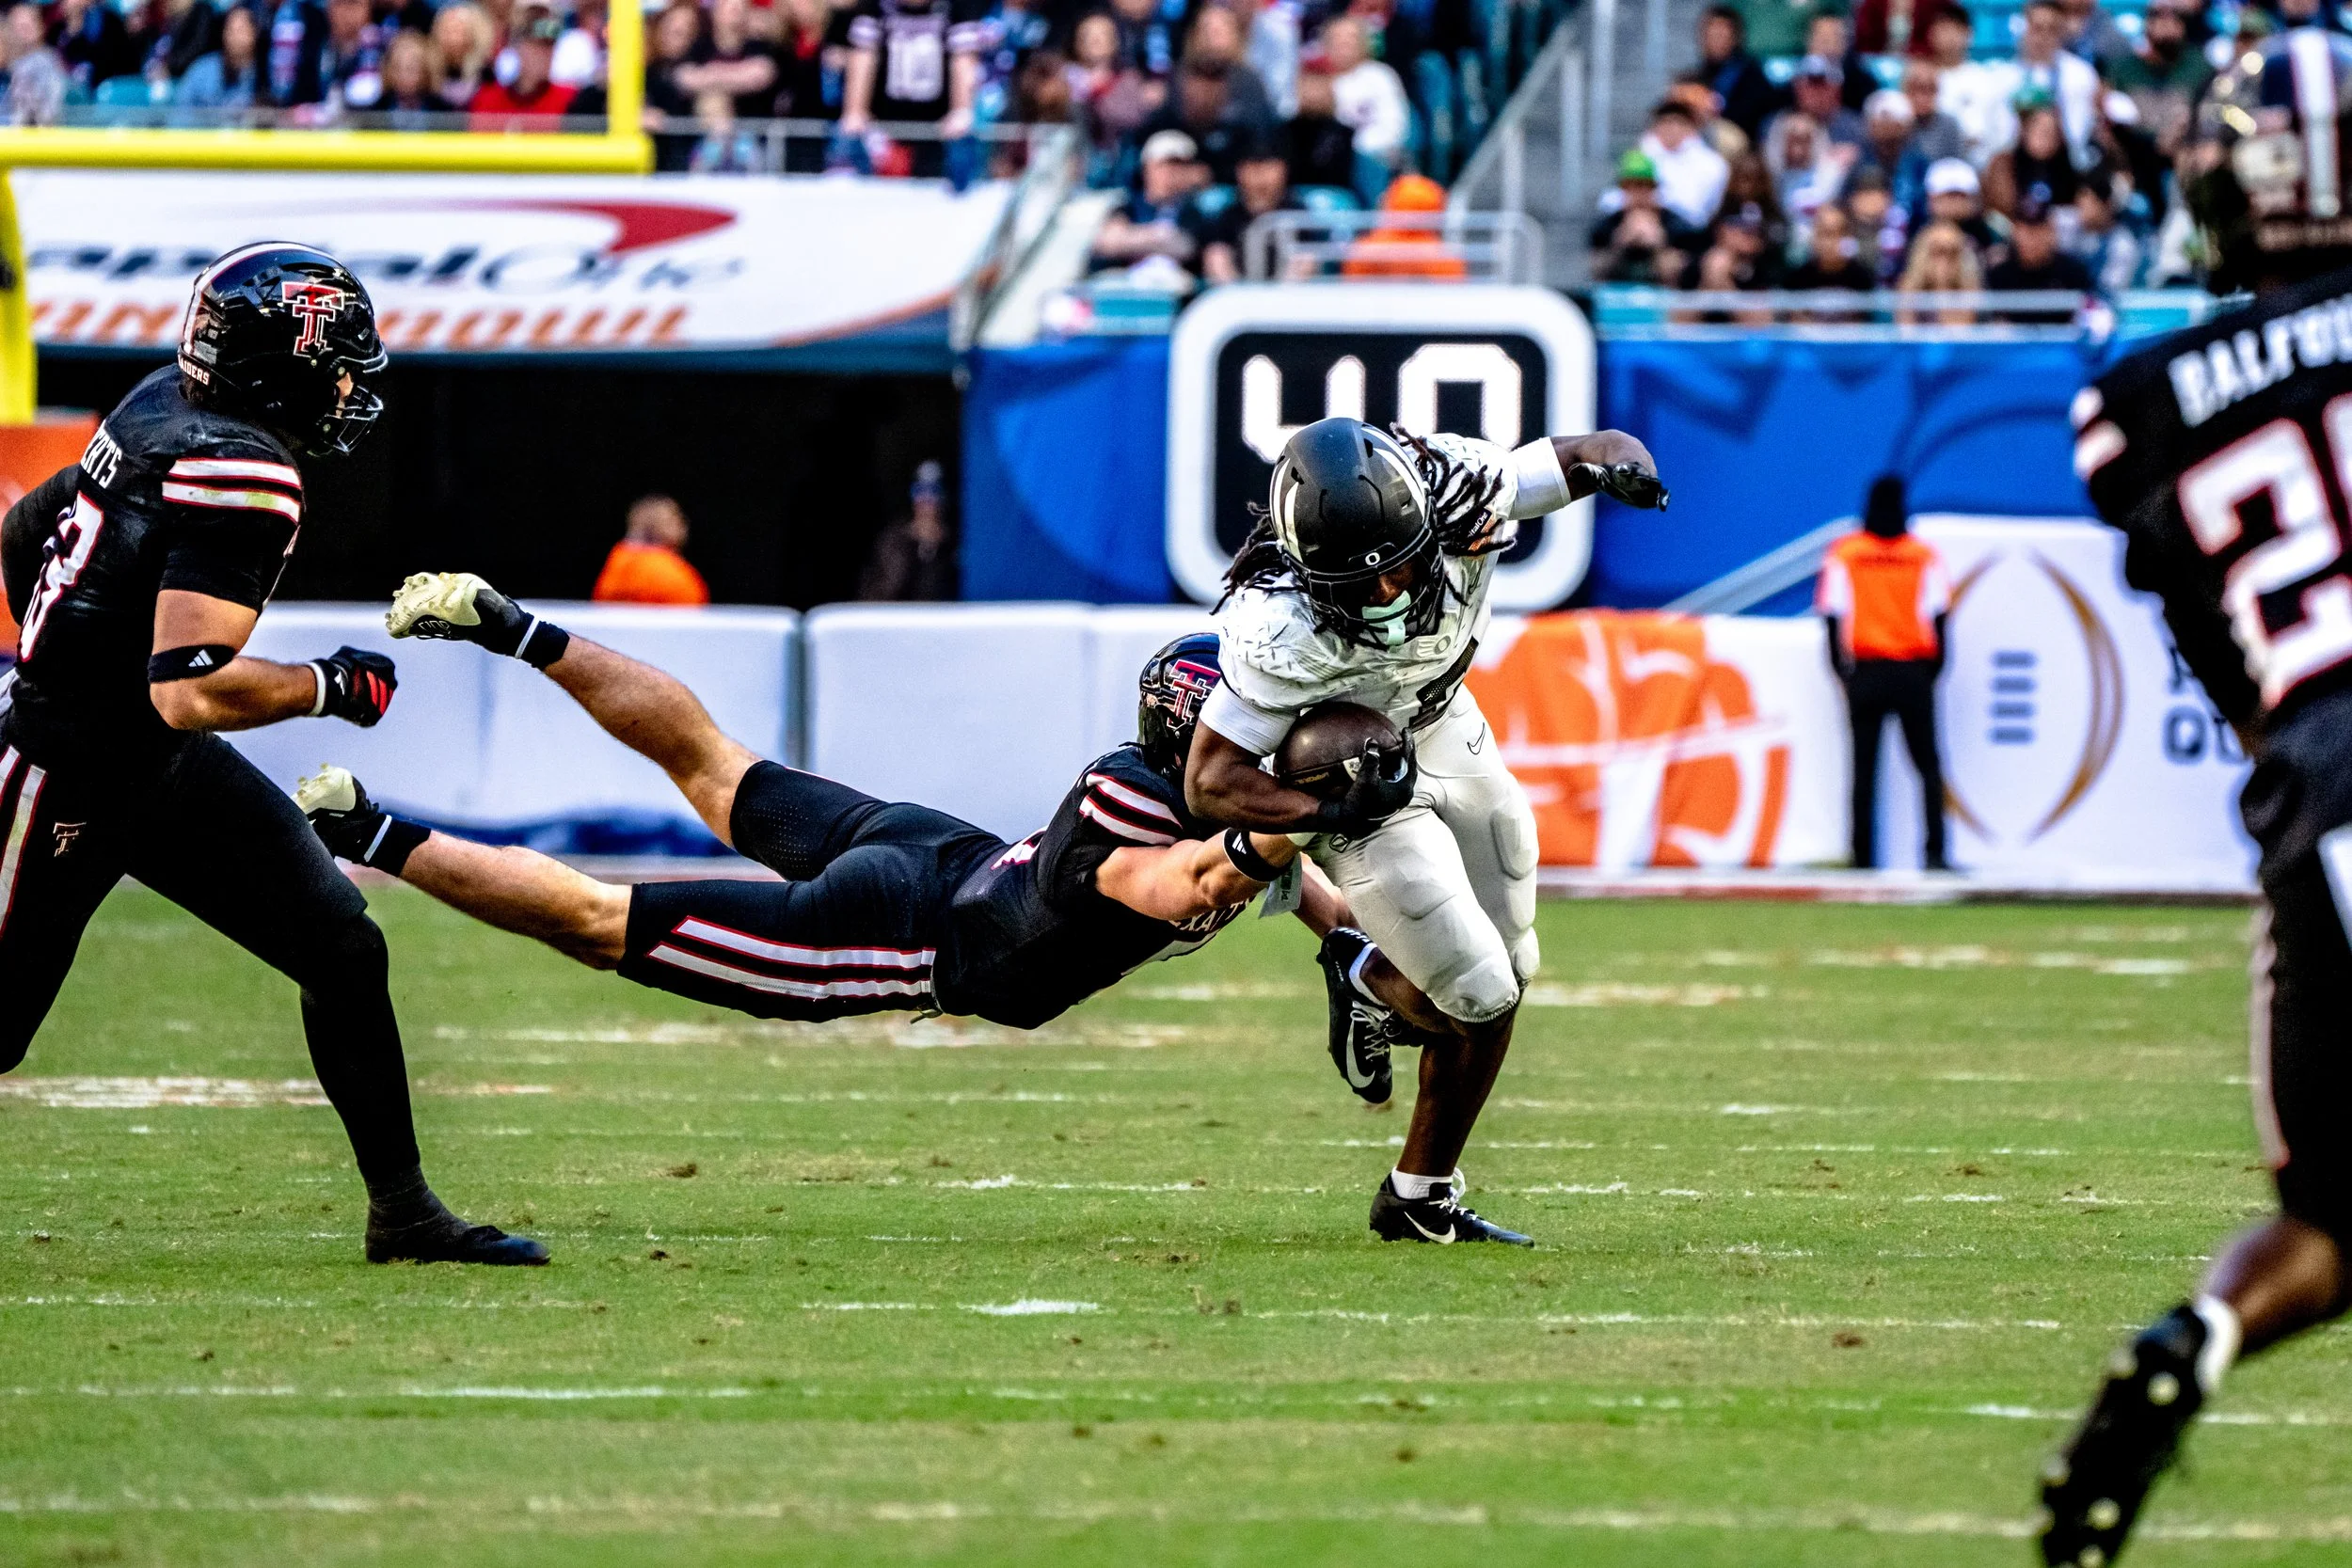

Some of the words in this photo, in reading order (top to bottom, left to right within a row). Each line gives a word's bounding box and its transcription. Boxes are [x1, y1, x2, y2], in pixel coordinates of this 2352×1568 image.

[178, 354, 210, 386] AIDERS
[80, 419, 122, 489] ERTS
[1468, 512, 1488, 537] italOne
[2176, 391, 2352, 712] 2
